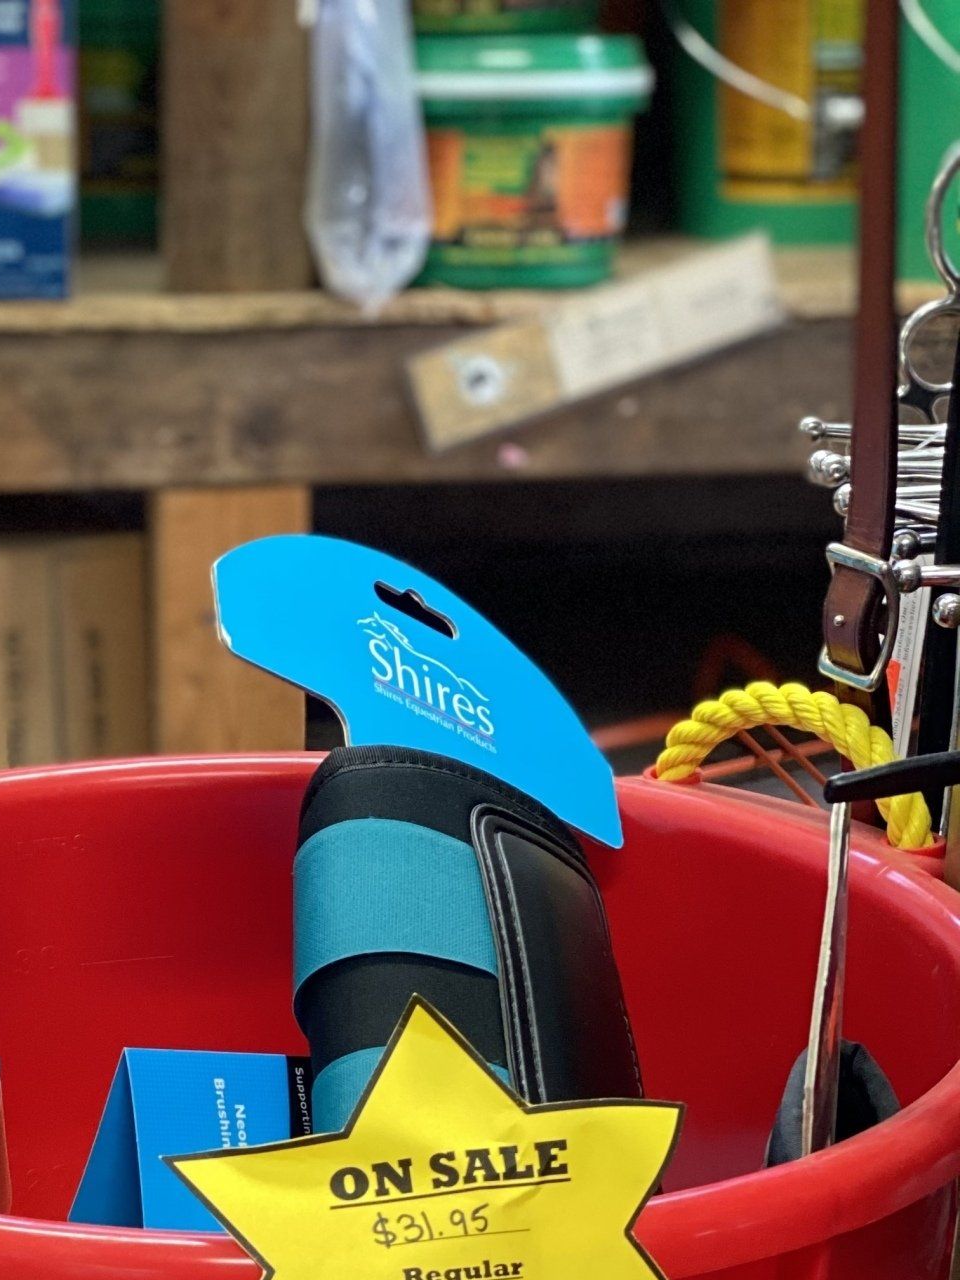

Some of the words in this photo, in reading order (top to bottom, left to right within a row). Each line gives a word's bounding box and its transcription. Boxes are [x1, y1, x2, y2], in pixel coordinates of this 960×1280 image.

[369, 639, 495, 736] Shires
[374, 681, 404, 704] Shires
[406, 698, 454, 730] Equestrian
[457, 726, 497, 754] Products
[330, 1158, 413, 1200] ON
[429, 1139, 568, 1189] SALE
[372, 1203, 489, 1248] $31.95
